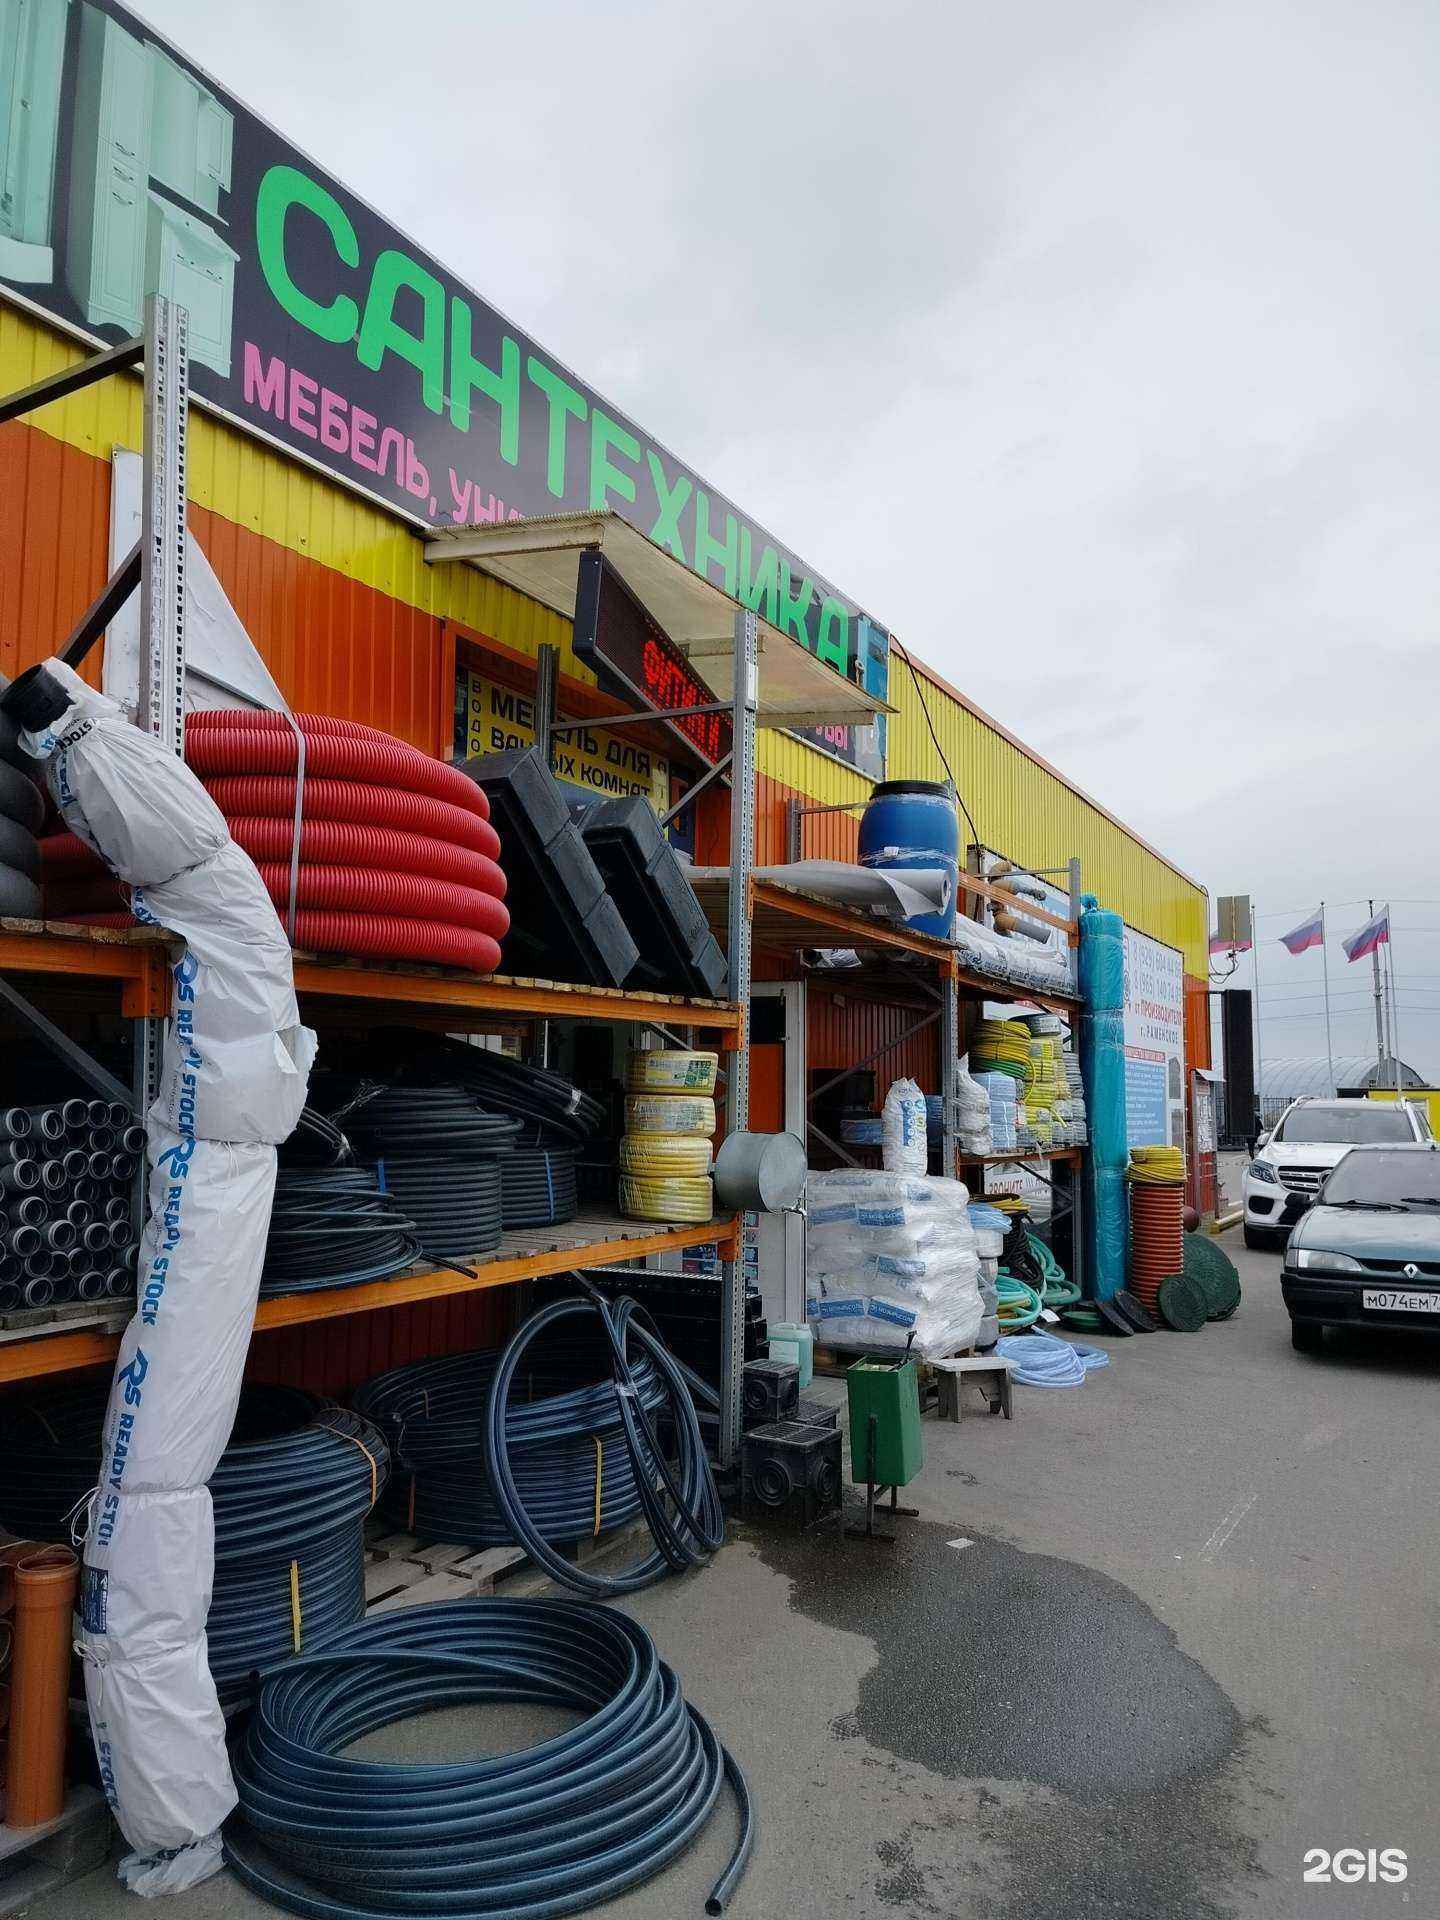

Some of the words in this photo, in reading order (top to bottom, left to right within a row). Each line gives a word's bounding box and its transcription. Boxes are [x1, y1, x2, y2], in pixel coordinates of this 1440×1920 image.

[244, 341, 437, 517] МЕБЕЛЬ,
[256, 165, 848, 677] САНТЕХНИКА
[605, 739, 651, 778] ДЛЯ
[178, 1073, 197, 1138] STOCK
[163, 1185, 183, 1252] READY
[141, 1257, 170, 1327] STOCK
[109, 1413, 135, 1490] READY
